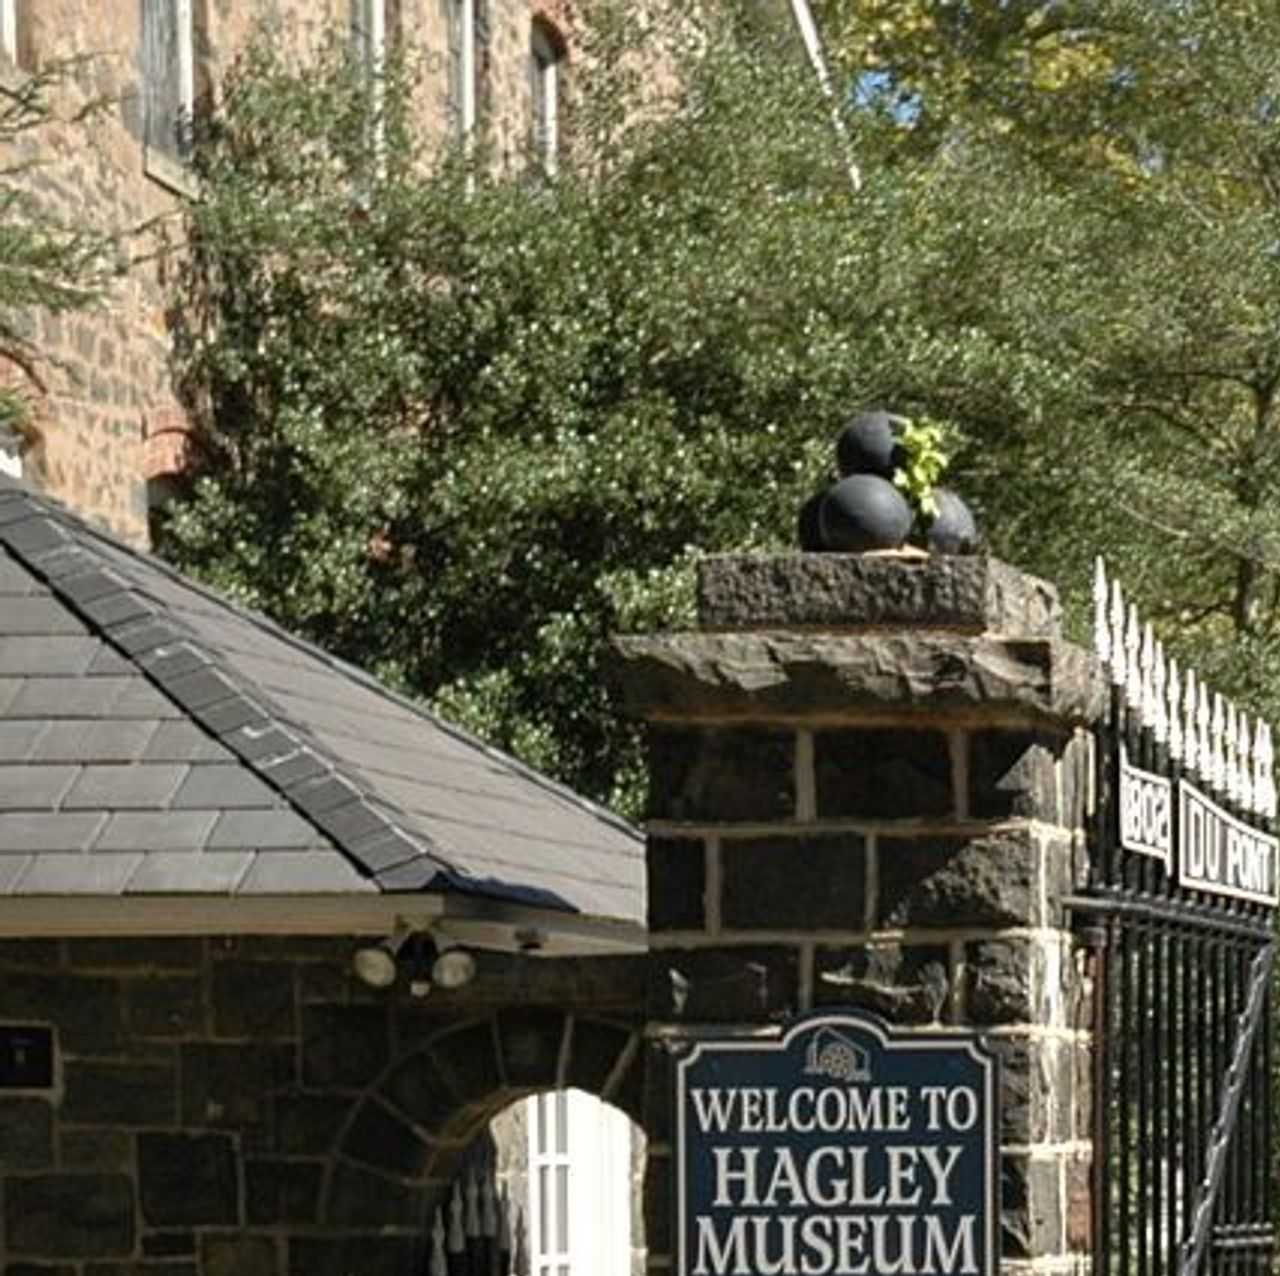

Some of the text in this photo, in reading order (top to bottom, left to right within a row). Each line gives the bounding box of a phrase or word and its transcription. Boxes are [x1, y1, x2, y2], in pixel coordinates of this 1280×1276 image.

[1189, 798, 1220, 881] DU
[692, 1086, 977, 1132] WELCOME TO
[713, 1146, 962, 1206] HAGLEY
[694, 1215, 978, 1275] MUSEUM
